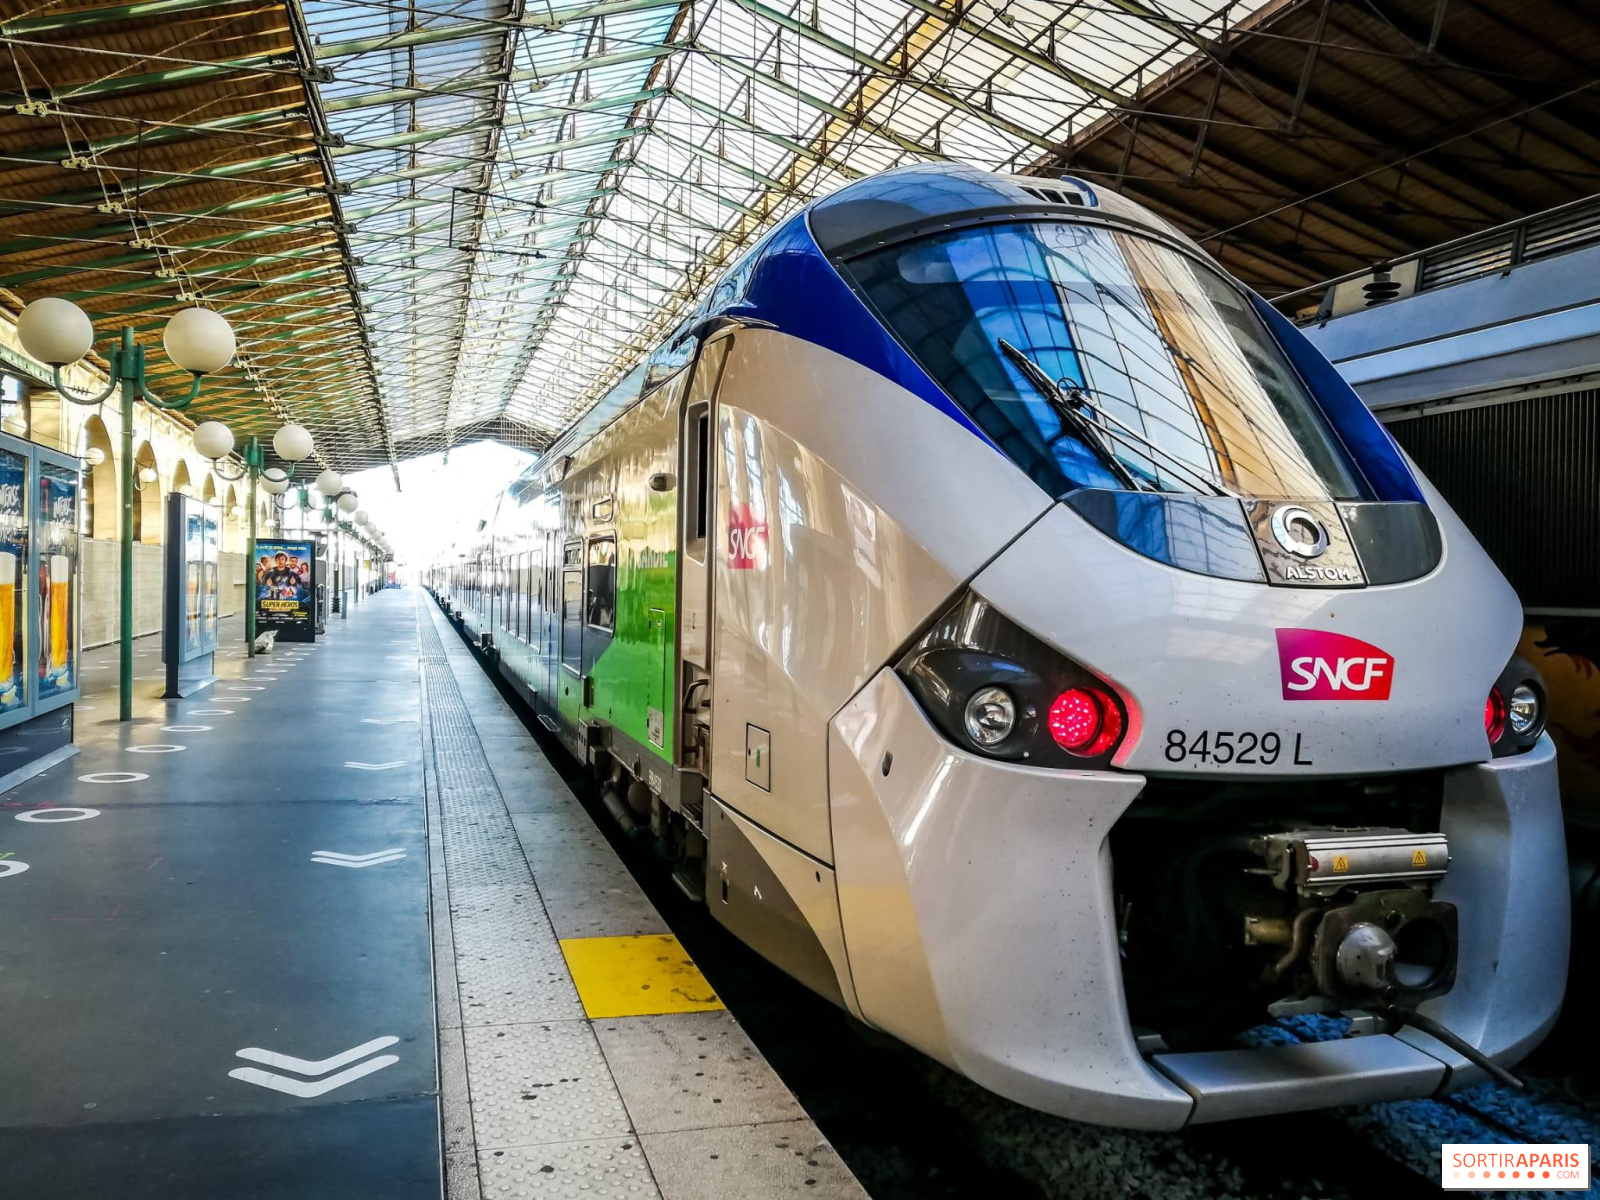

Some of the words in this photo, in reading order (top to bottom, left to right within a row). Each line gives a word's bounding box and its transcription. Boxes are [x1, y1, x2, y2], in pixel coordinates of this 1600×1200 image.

[1286, 566, 1351, 580] ALSTOM
[262, 600, 280, 608] SUPER
[1287, 657, 1387, 691] SNCF
[1164, 729, 1281, 765] 84529
[1293, 732, 1313, 766] L
